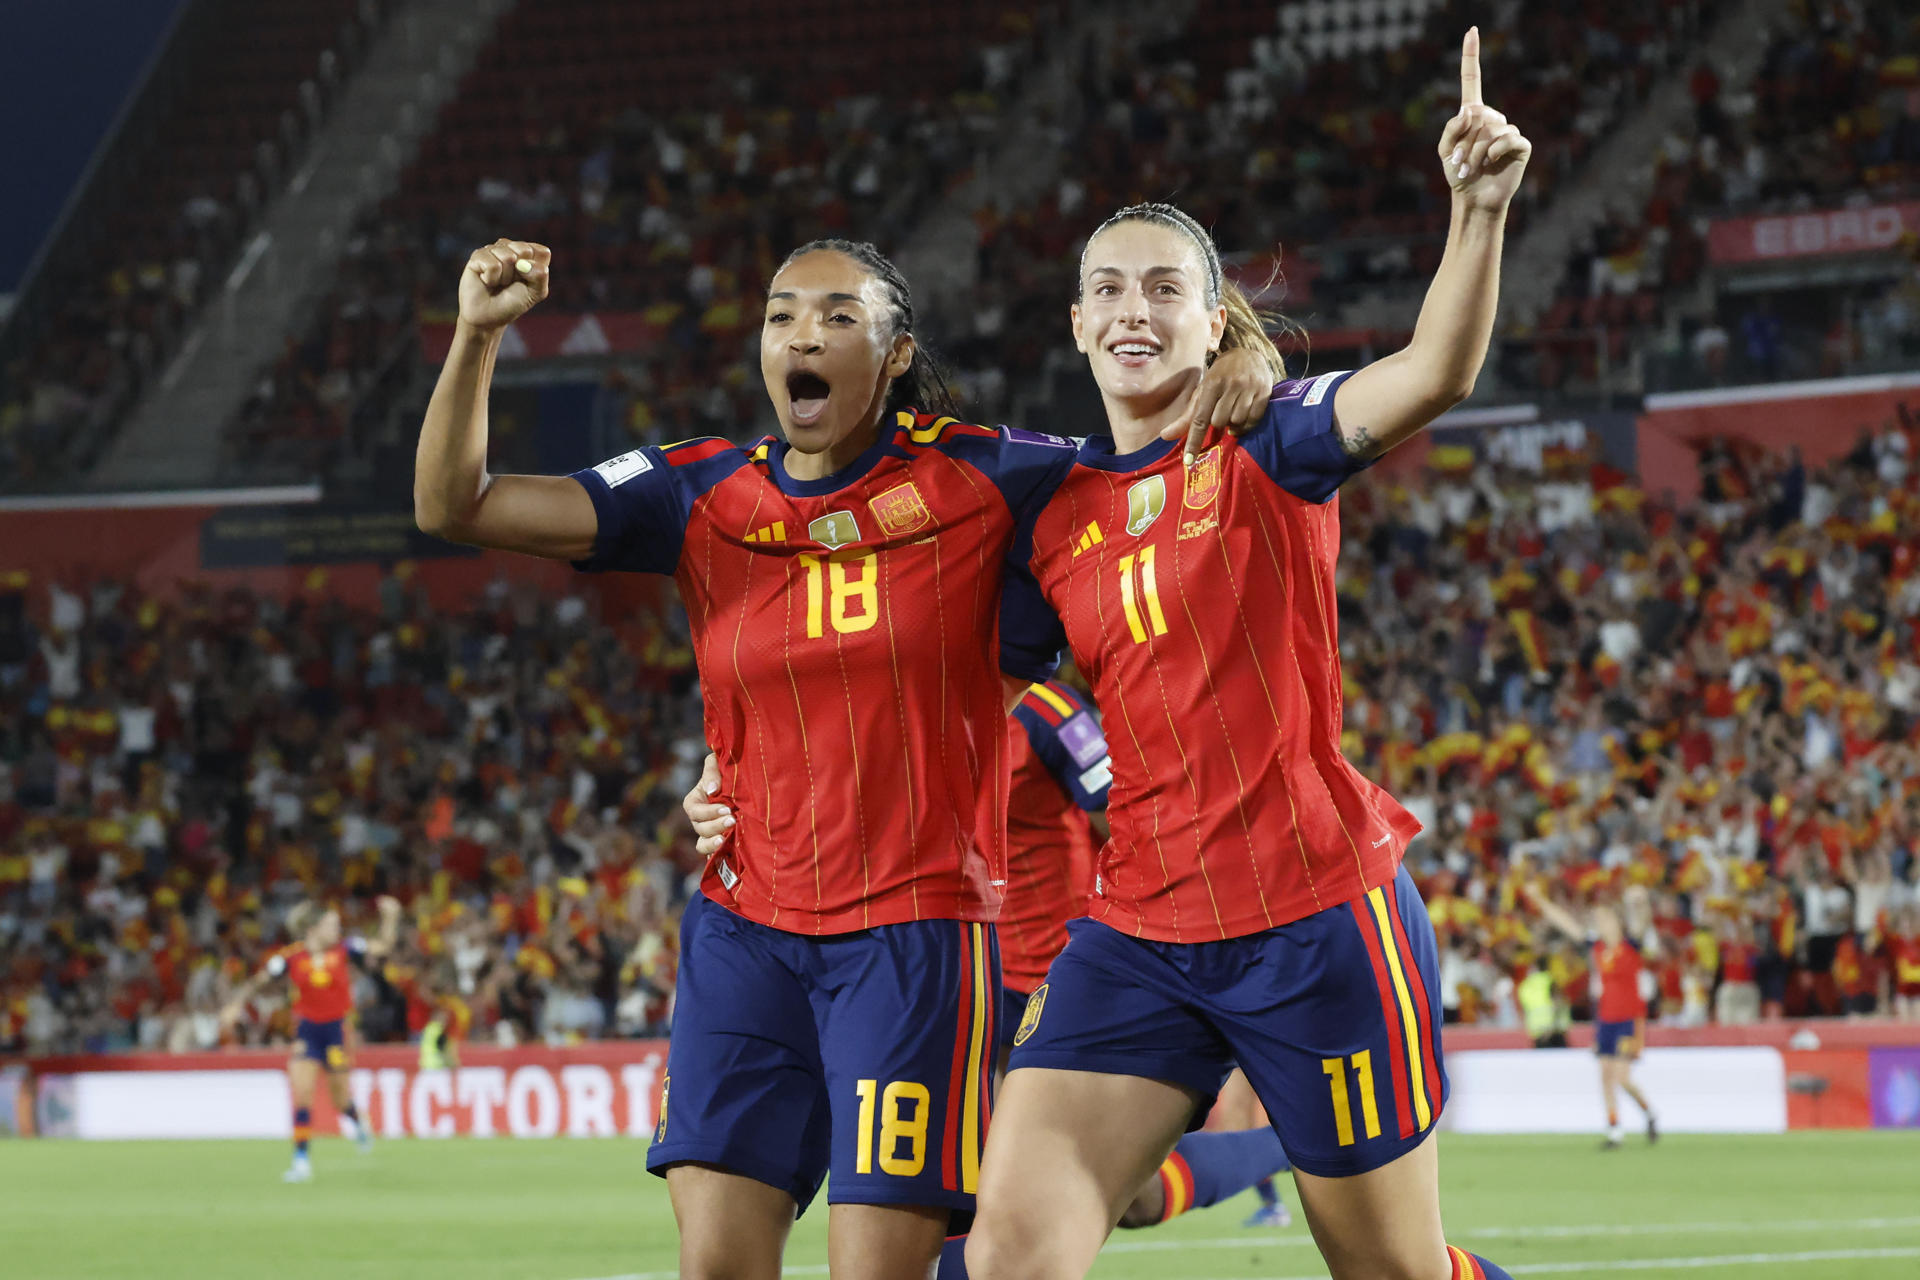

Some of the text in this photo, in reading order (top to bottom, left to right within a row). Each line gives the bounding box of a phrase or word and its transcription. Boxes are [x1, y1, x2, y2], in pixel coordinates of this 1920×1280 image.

[799, 549, 878, 638] 18
[1118, 544, 1168, 644] 11
[856, 1079, 930, 1176] 18
[1322, 1049, 1381, 1146] 11
